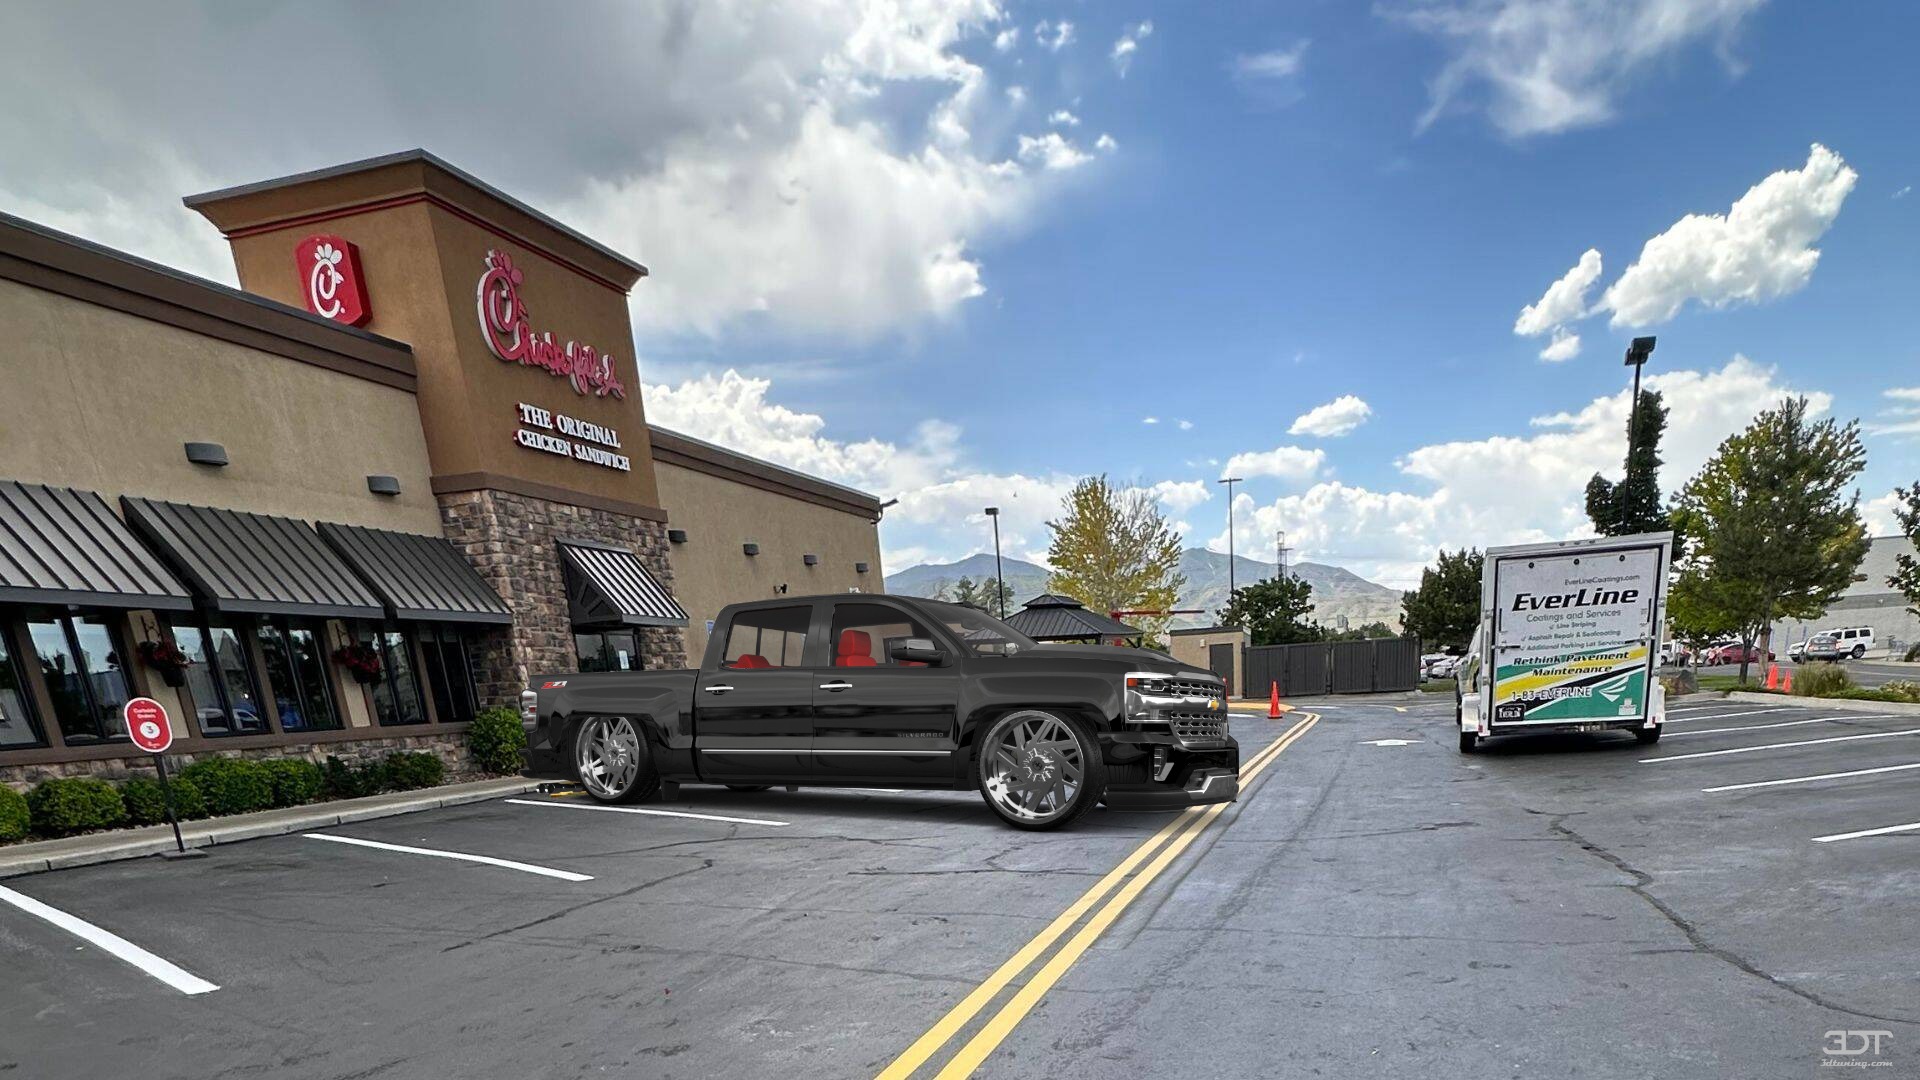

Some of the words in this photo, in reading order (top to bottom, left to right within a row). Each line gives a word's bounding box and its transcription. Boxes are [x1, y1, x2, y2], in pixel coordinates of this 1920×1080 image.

[519, 402, 552, 430] THE
[556, 414, 621, 448] ORIGINAL
[517, 429, 573, 459] CHICKEN
[574, 443, 631, 472] SANDWICH
[1564, 574, 1641, 586] EverLineCoatings.com
[1511, 587, 1639, 612] EverLine
[1526, 613, 1564, 623] Coatings
[1566, 611, 1584, 620] and
[1586, 609, 1621, 619] Services
[1513, 655, 1561, 666] Rethink
[1566, 651, 1630, 663] Pavement
[1532, 665, 1613, 677] Maintenance
[145, 725, 154, 734] 3
